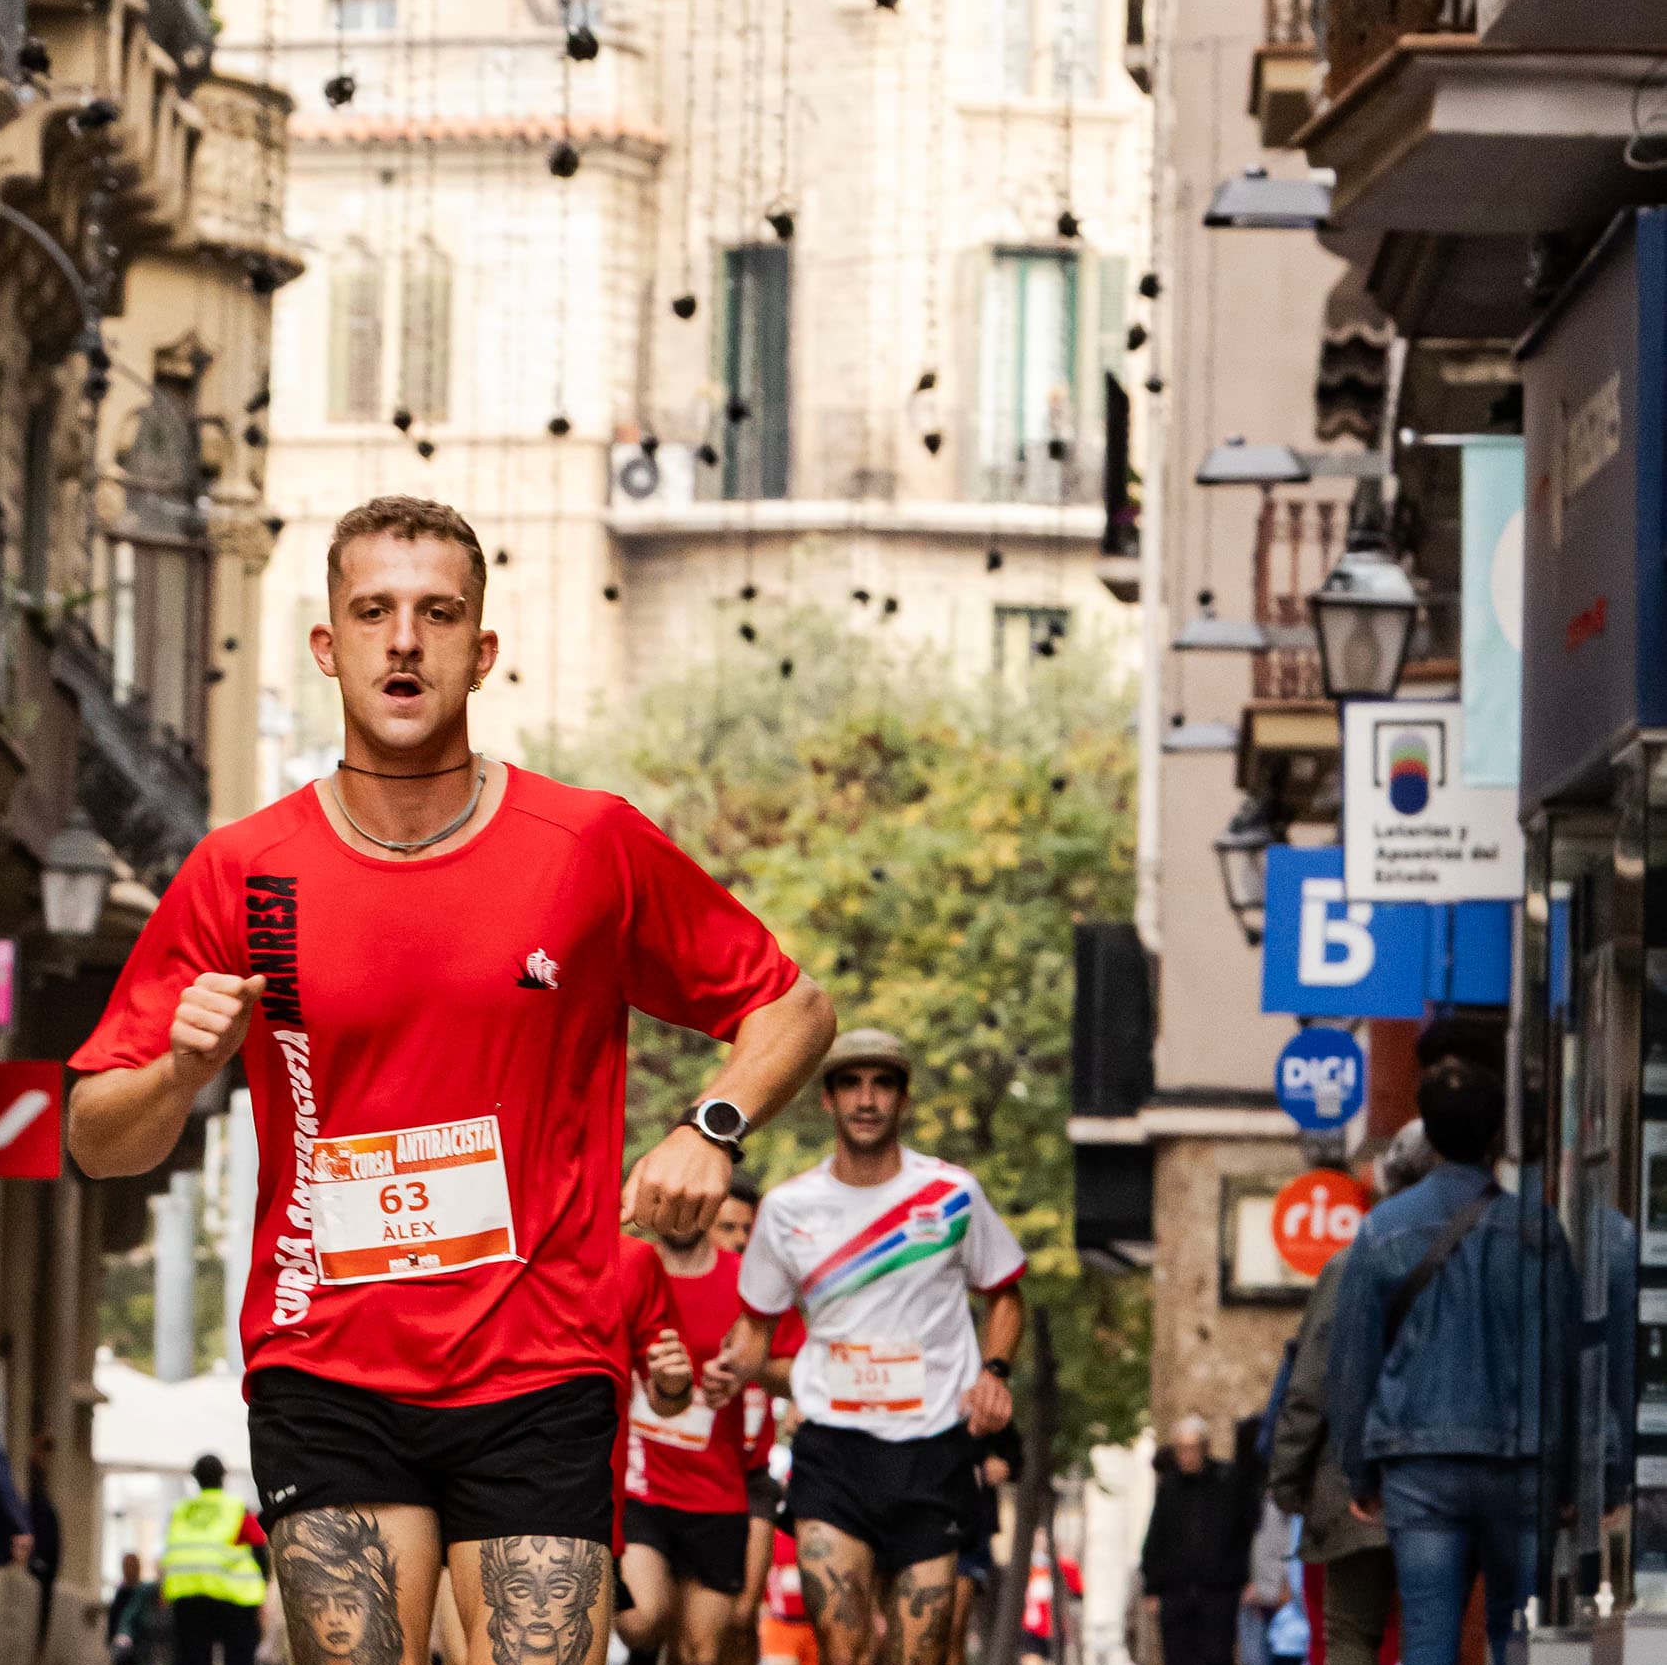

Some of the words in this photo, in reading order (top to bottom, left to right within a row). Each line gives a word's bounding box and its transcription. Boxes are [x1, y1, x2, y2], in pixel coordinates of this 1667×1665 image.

[245, 875, 304, 1026] MANRESA
[1283, 1056, 1356, 1088] DIGI
[350, 1149, 396, 1180] CURSA
[396, 1120, 495, 1164] ANTIRACISTA
[379, 1181, 430, 1215] 63
[382, 1220, 438, 1242] ÀLEX
[271, 1235, 319, 1326] CURSA
